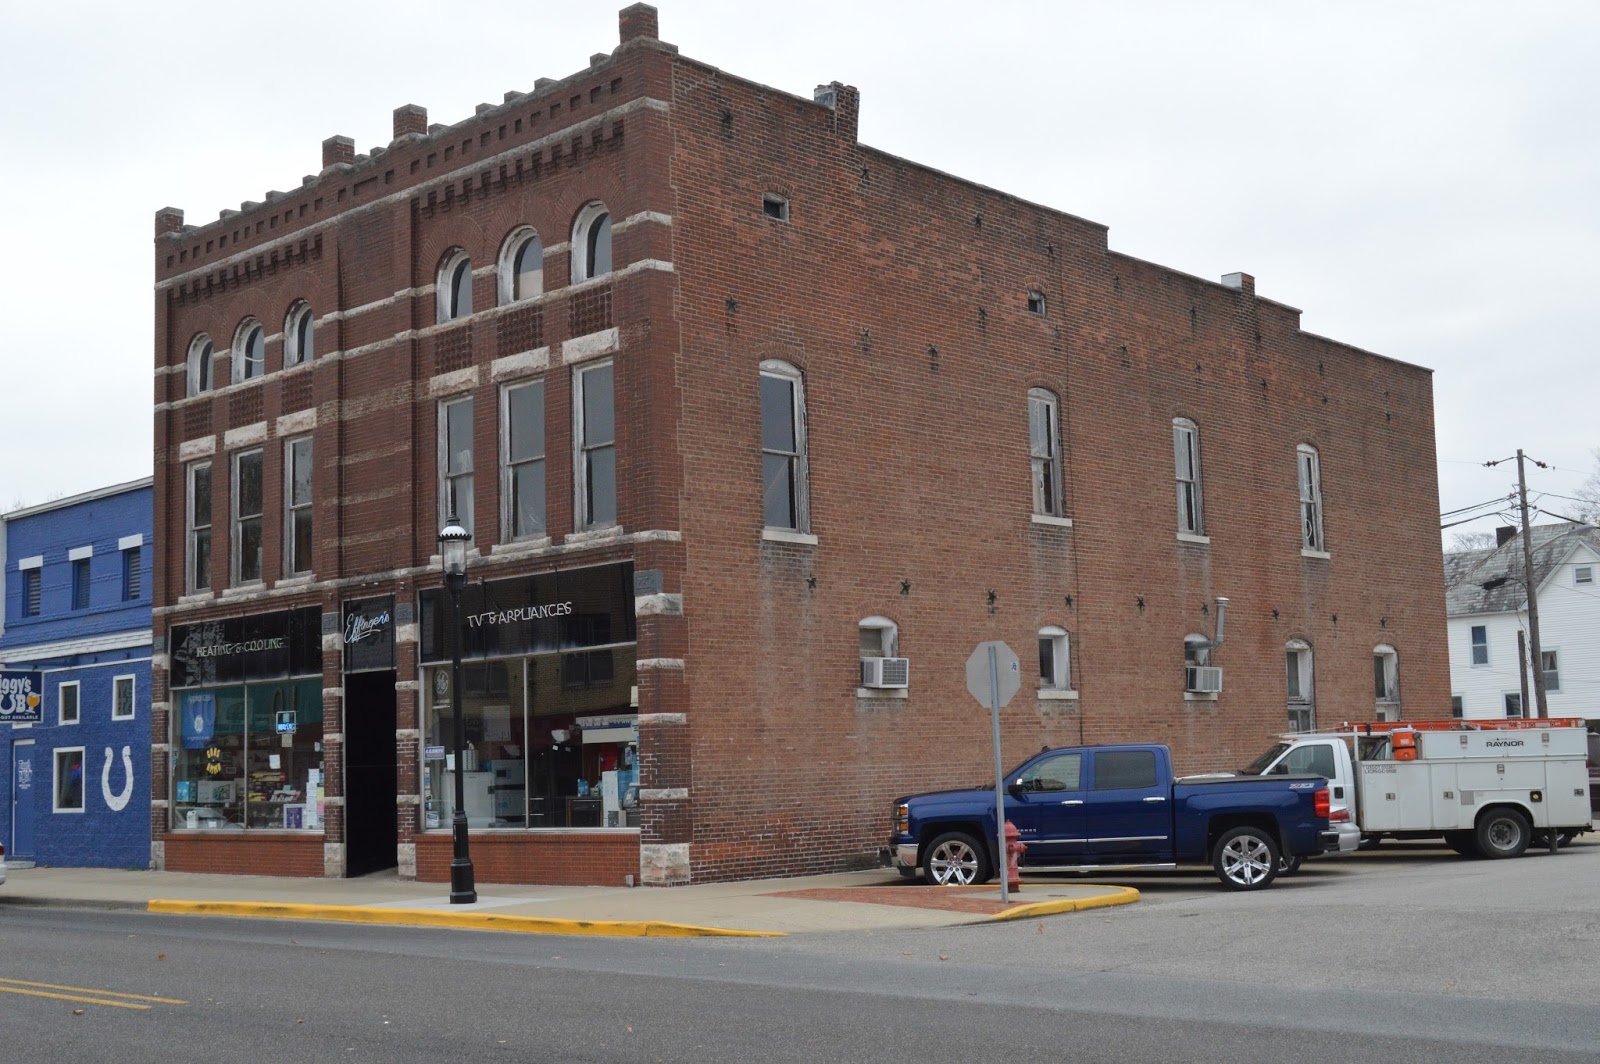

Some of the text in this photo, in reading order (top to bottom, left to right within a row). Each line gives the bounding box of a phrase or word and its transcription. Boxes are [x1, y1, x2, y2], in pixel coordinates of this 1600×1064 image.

[467, 615, 484, 627] TV
[196, 644, 232, 657] HEATING
[244, 638, 284, 652] COOLING
[1486, 740, 1524, 748] RAYNOR
